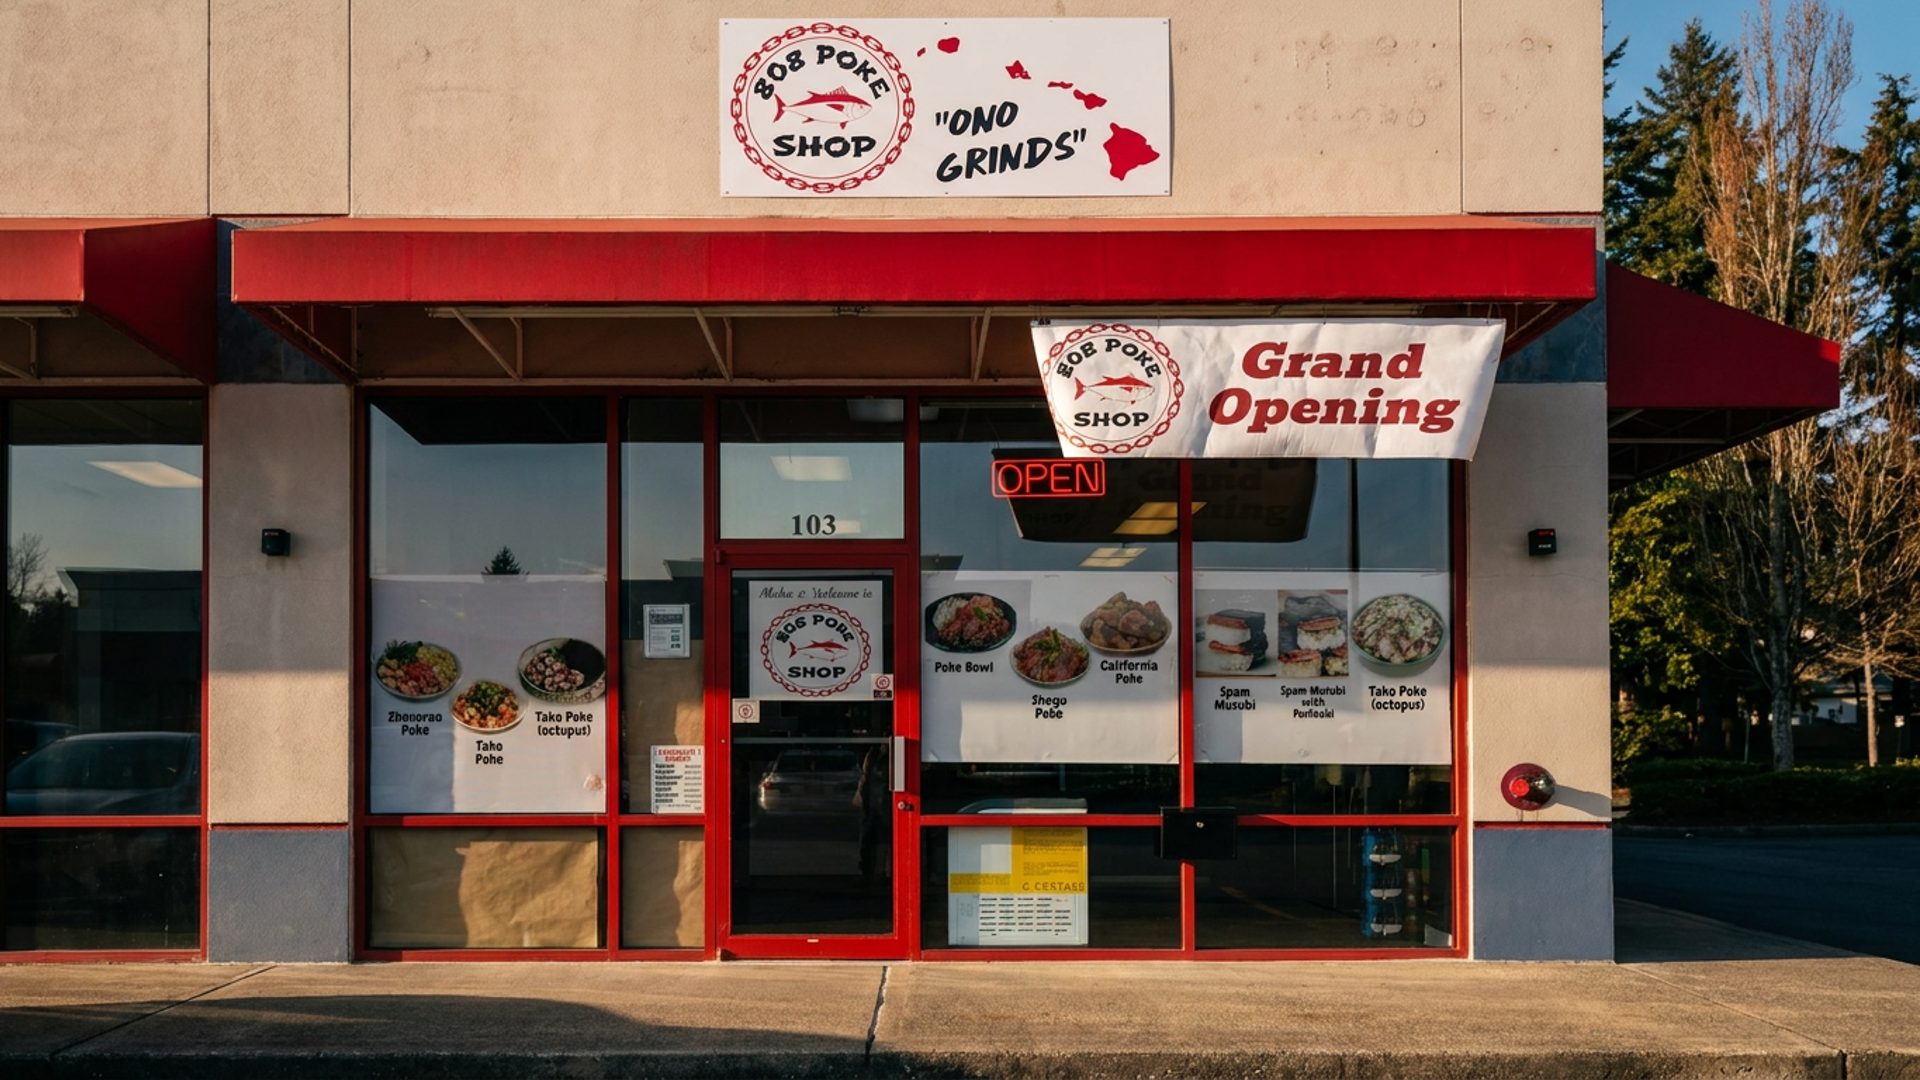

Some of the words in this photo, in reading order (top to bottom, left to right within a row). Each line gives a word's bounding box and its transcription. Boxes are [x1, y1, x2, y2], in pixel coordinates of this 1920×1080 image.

[754, 50, 805, 100] 808
[816, 45, 890, 99] POKE
[935, 101, 1019, 136] "ONO
[772, 134, 876, 158] SHOP
[936, 129, 1086, 183] GRINDS"
[1242, 341, 1426, 380] Grand
[1074, 412, 1149, 427] SHOP
[1208, 387, 1460, 434] Opening
[997, 463, 1099, 494] OPEN
[791, 514, 837, 536] 103
[1220, 685, 1250, 700] Spam
[1368, 685, 1396, 697] Tako
[1399, 685, 1427, 697] Poke
[535, 711, 563, 722] Tako
[1371, 698, 1425, 713] (octopus)
